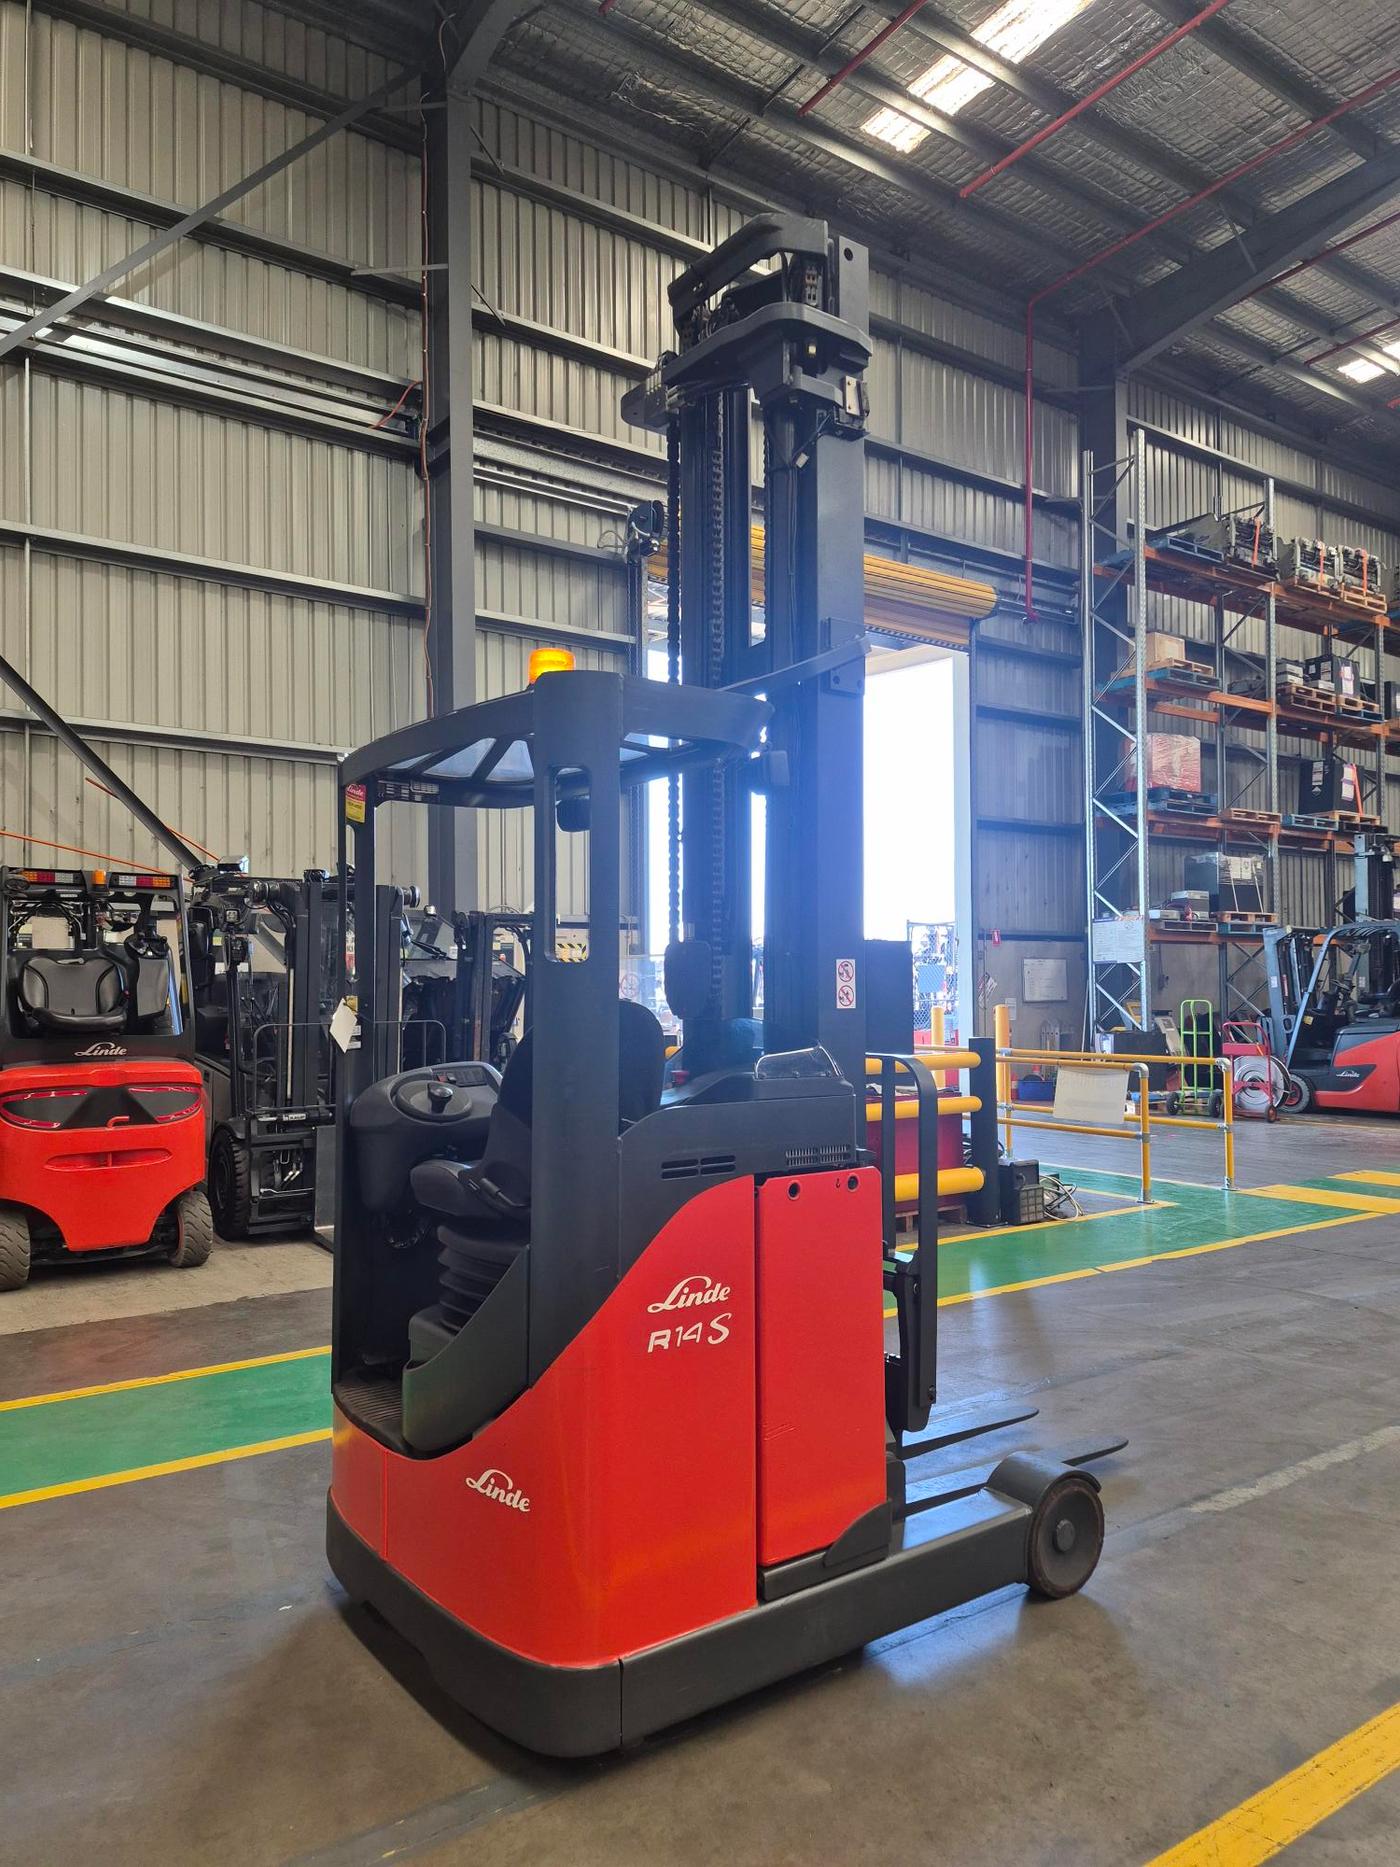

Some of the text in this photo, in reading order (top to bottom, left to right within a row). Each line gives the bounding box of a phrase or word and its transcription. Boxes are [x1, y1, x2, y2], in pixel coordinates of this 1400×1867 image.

[74, 1041, 127, 1057] Linde
[647, 1275, 731, 1313] Linde
[465, 1468, 531, 1512] Linde
